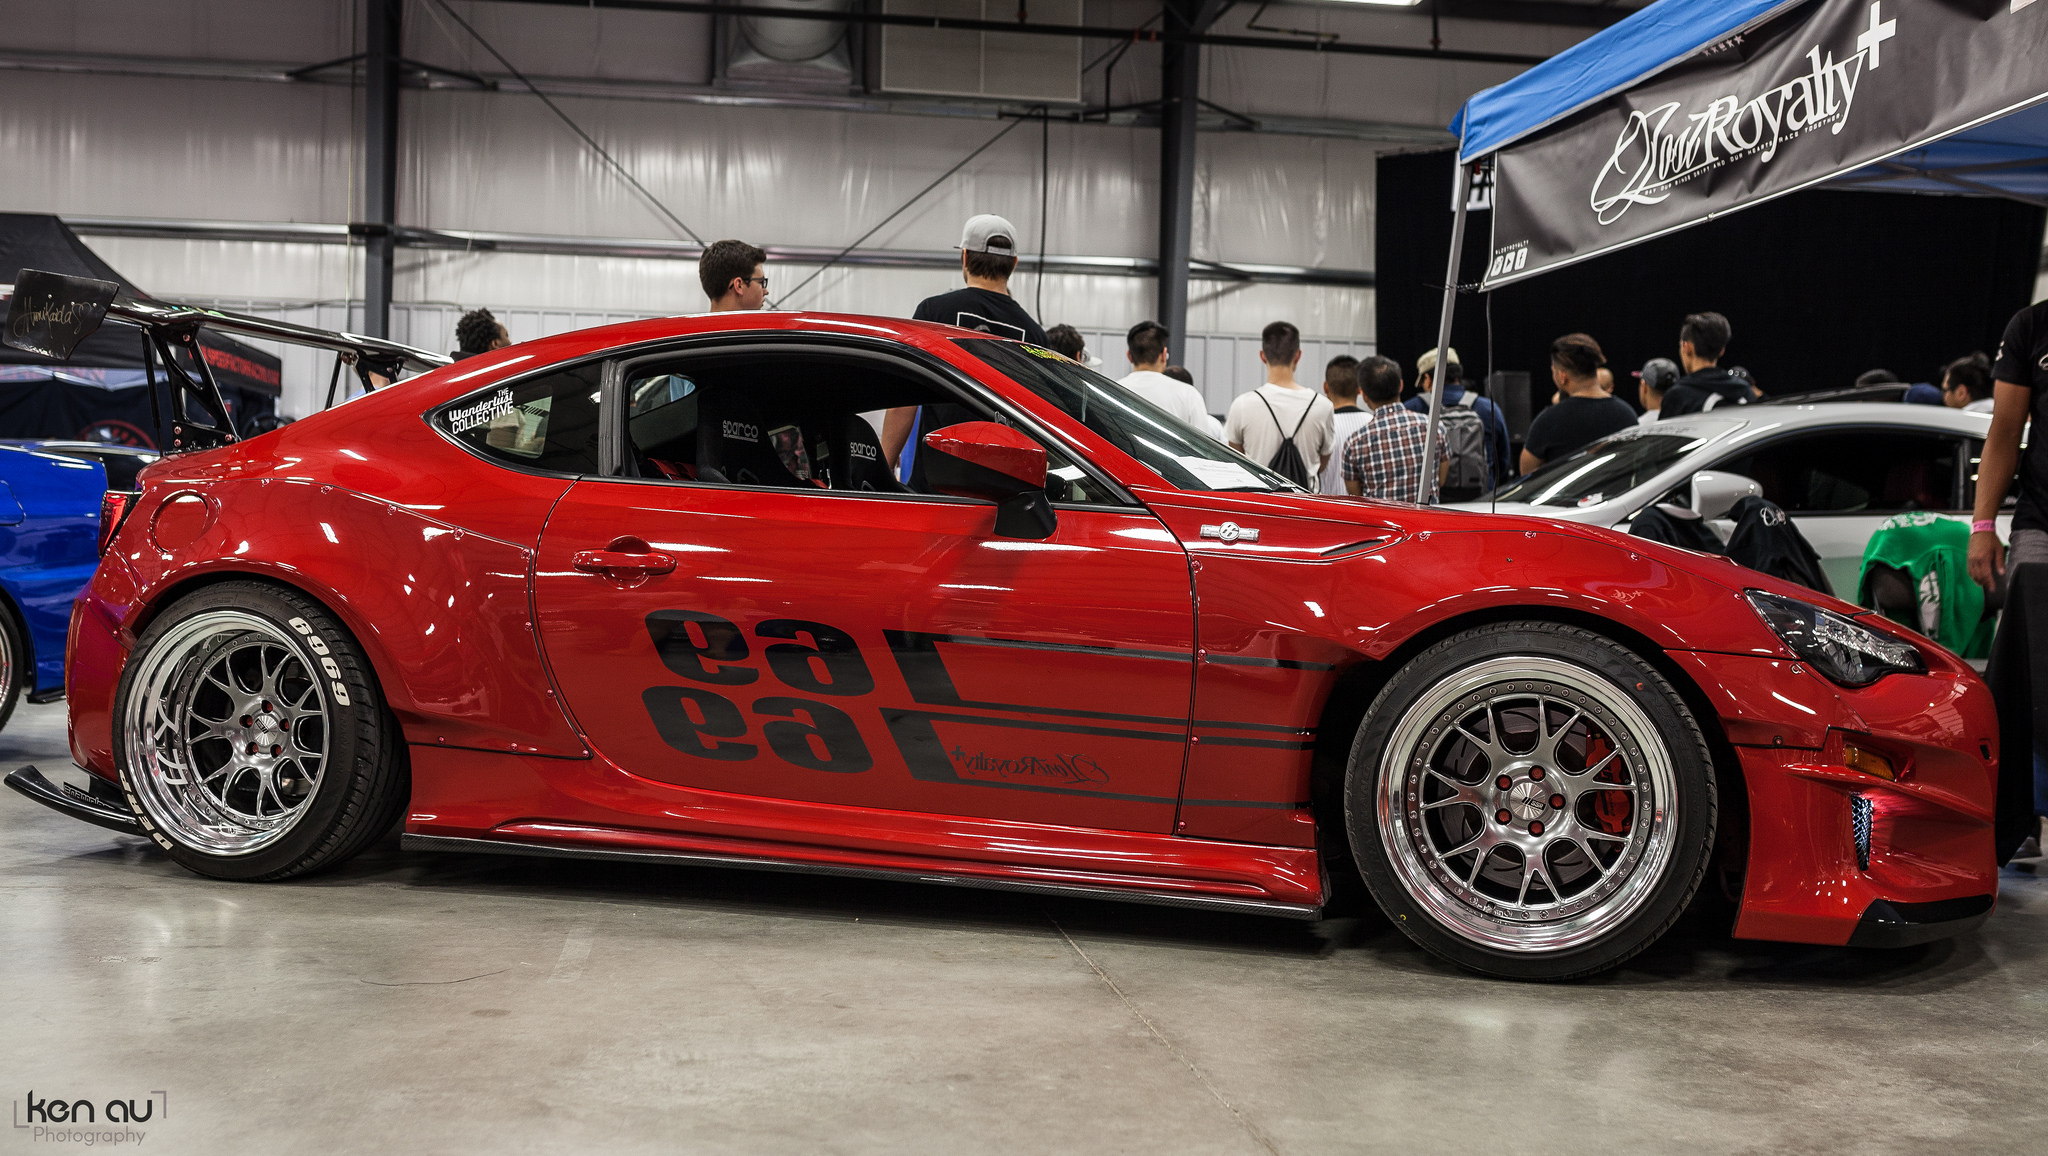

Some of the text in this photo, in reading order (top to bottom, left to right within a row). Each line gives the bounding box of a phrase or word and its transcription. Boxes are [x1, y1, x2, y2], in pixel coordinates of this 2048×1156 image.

[1713, 160, 1726, 169] AND
[1729, 153, 1744, 162] OUR
[1778, 132, 1799, 143] RACE
[448, 391, 514, 422] Wanderlust
[497, 387, 509, 397] THE
[452, 401, 514, 435] COLLECTIVE
[722, 420, 759, 438] sparco
[850, 442, 877, 457] sparco
[288, 616, 351, 707] 6969
